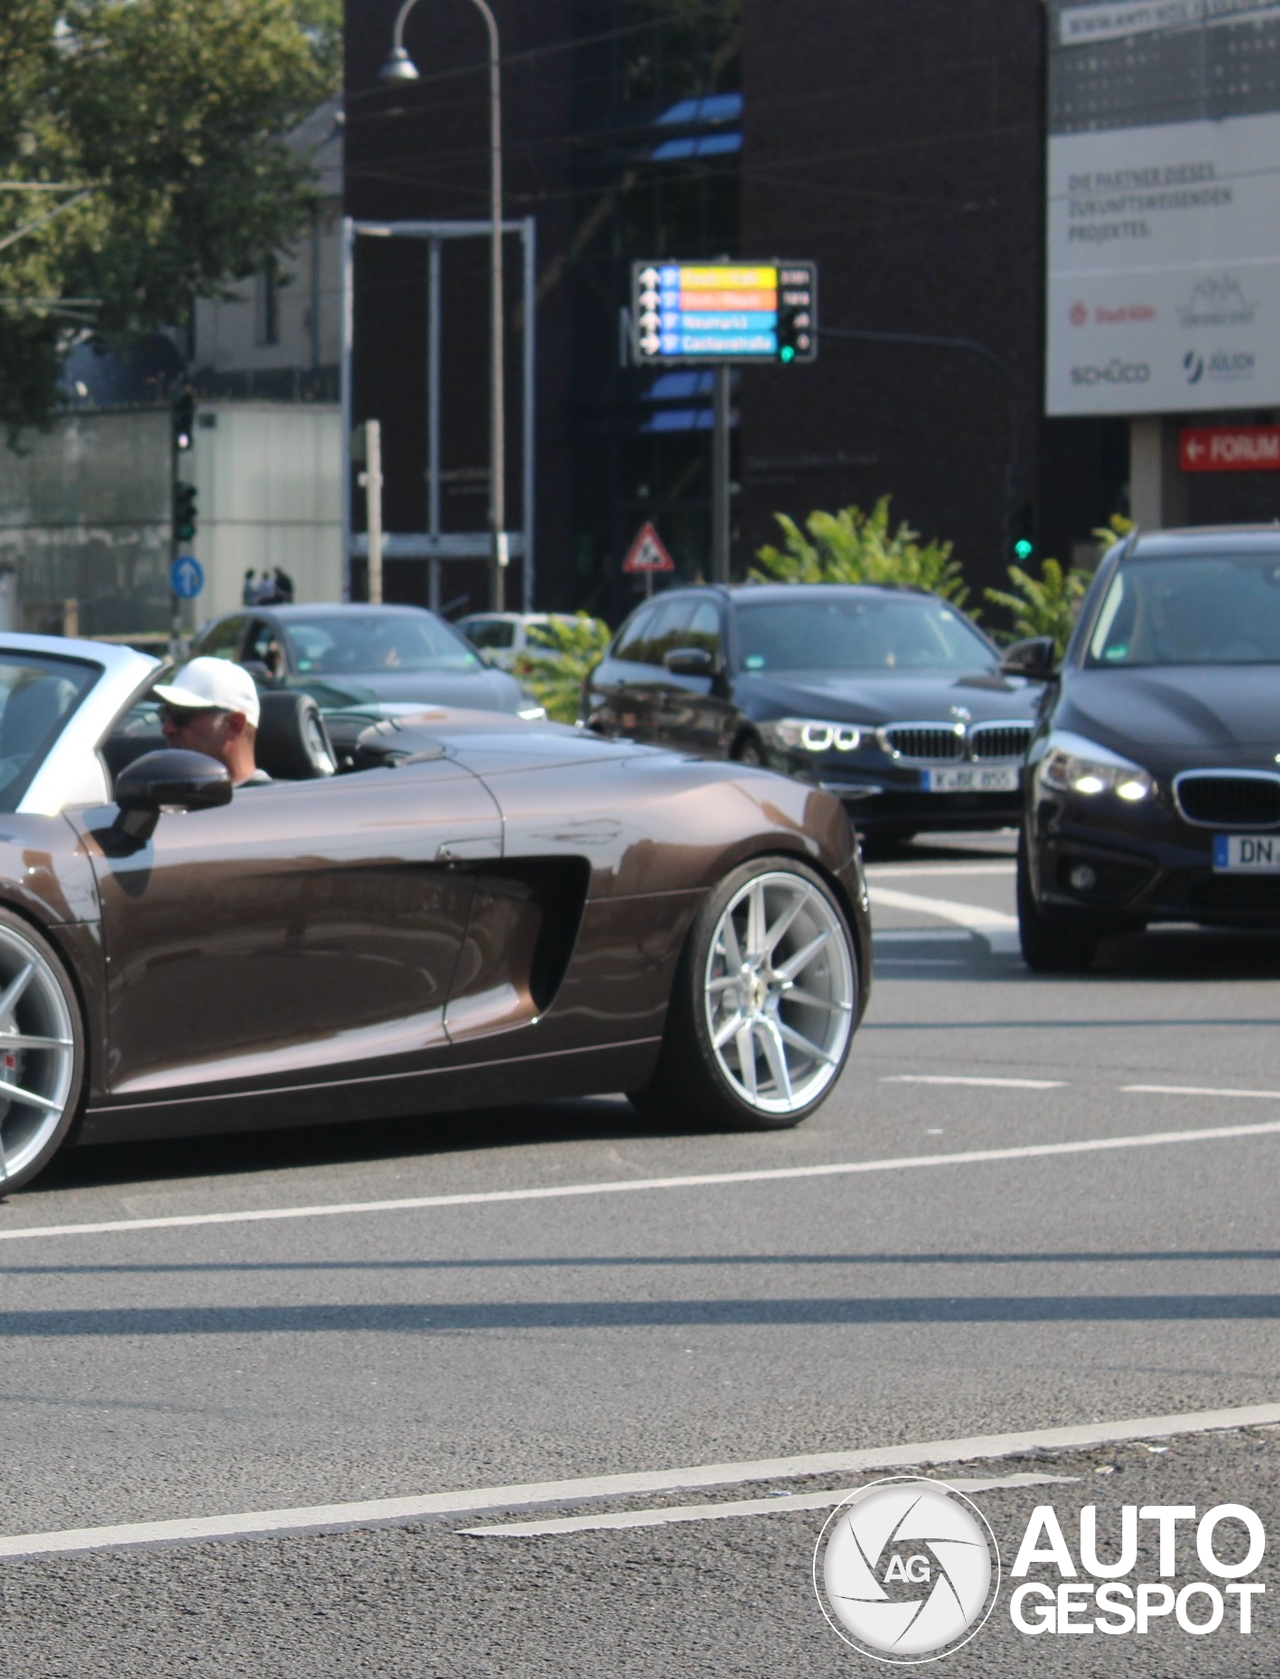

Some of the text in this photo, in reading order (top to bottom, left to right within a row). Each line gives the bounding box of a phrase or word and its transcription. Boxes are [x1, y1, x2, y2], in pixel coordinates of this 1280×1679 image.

[1095, 167, 1160, 186] PARTNER
[1071, 359, 1150, 384] SCHÜCO
[1210, 433, 1280, 462] FORUM
[1240, 839, 1273, 863] DN
